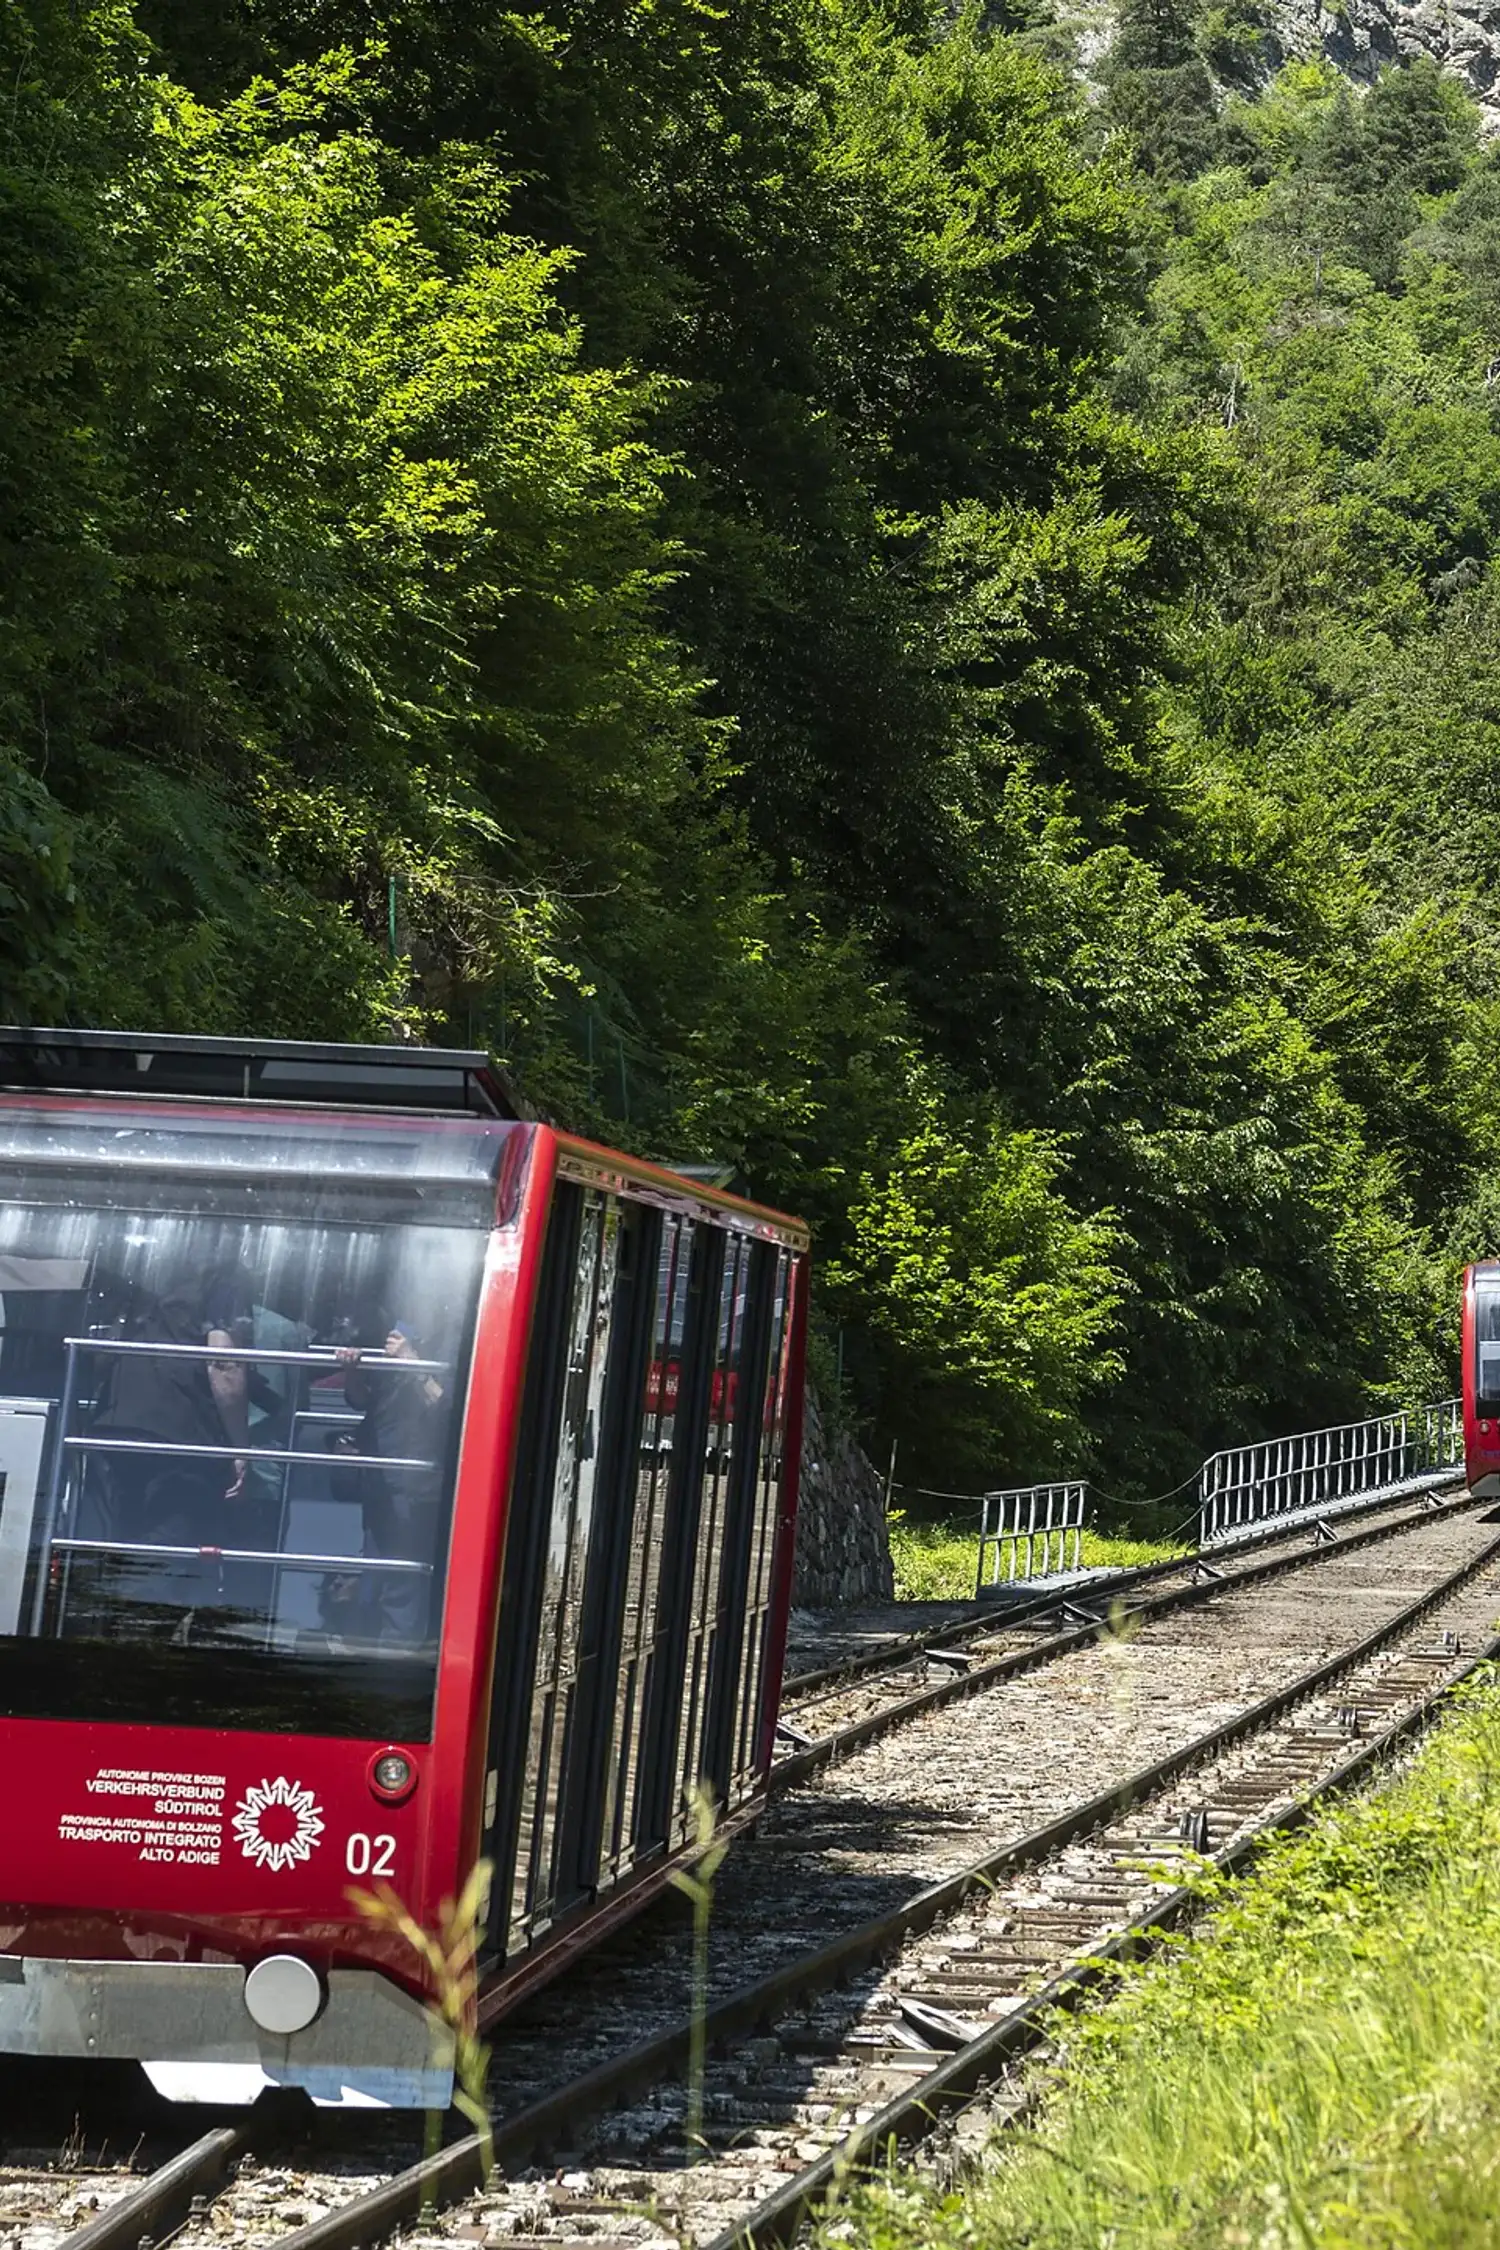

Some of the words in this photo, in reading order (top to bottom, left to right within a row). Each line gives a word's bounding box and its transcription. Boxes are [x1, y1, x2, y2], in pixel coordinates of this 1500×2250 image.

[97, 1769, 150, 1781] AUTONOME
[151, 1771, 193, 1784] PROVINZ
[194, 1774, 226, 1786] BOZEN
[86, 1780, 225, 1800] VERKEHRSVERBUND
[154, 1799, 223, 1816] SÜDTIROL
[61, 1815, 112, 1827] PROVINCIA
[113, 1818, 166, 1831] AUTONOMA
[166, 1821, 177, 1831] DI
[178, 1822, 222, 1834] BOLZANO
[58, 1826, 141, 1844] TRASPORTO
[144, 1833, 222, 1849] INTEGRATO
[139, 1847, 174, 1863] ALTO
[177, 1852, 220, 1865] ADIGE
[346, 1832, 396, 1876] 02
